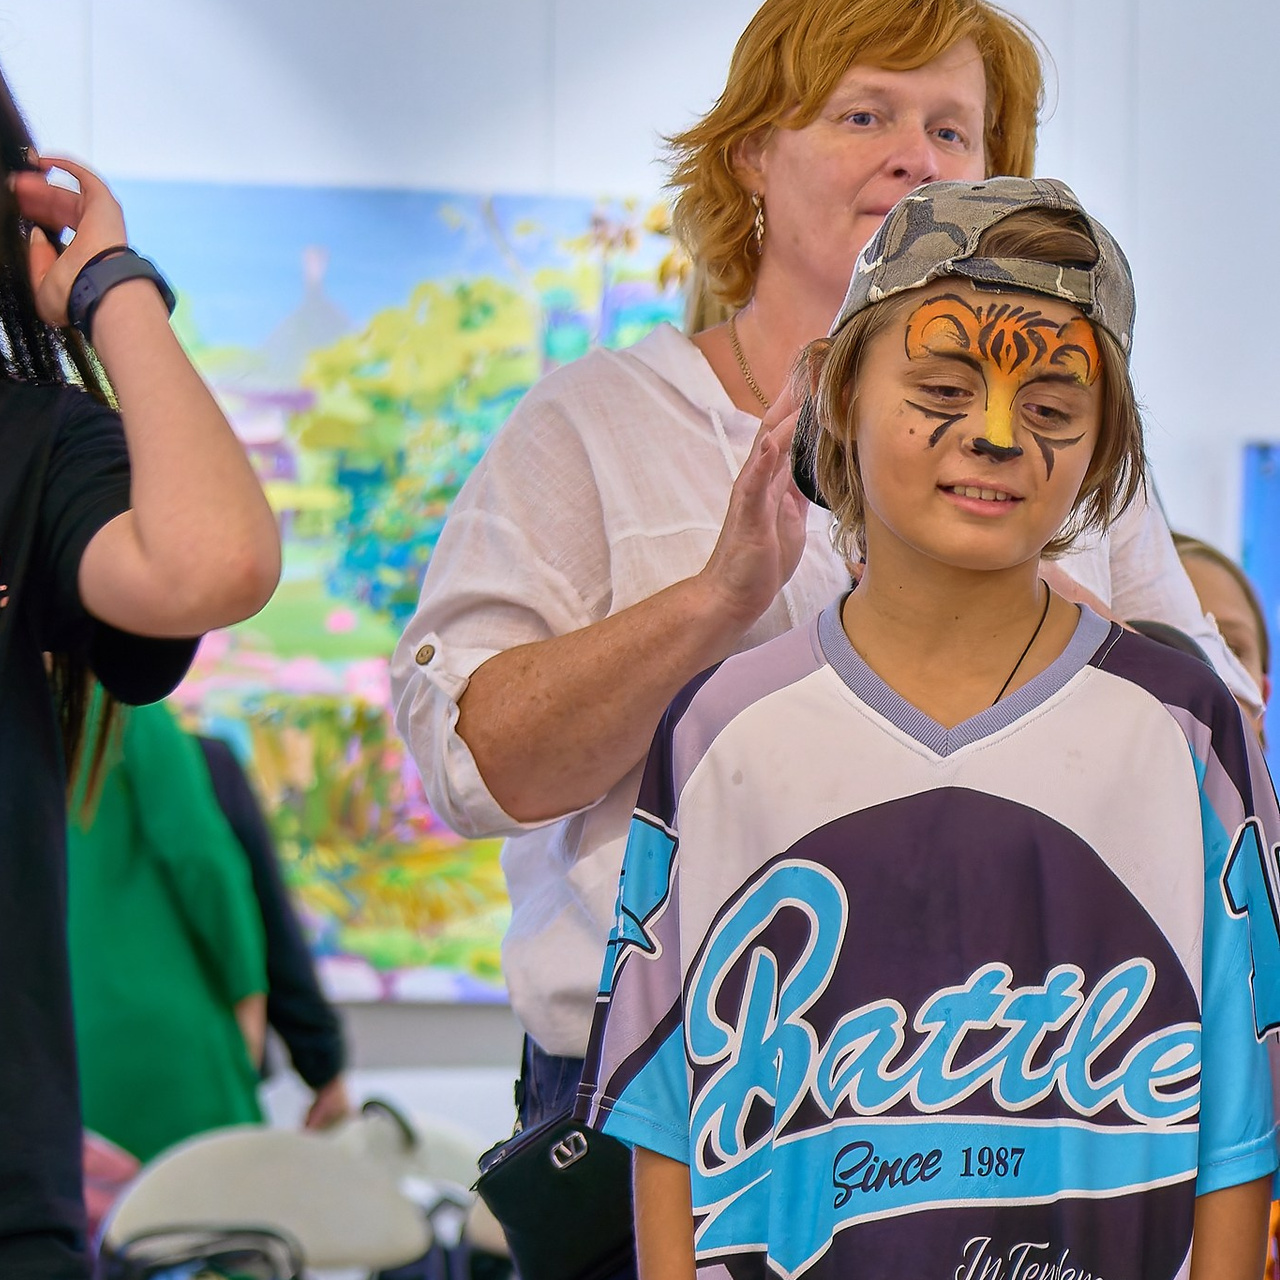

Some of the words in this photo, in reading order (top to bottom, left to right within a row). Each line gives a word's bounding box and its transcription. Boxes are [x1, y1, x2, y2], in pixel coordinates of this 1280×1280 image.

[684, 858, 1202, 1178] Battle
[832, 1140, 943, 1210] Since
[959, 1146, 1026, 1178] 1987
